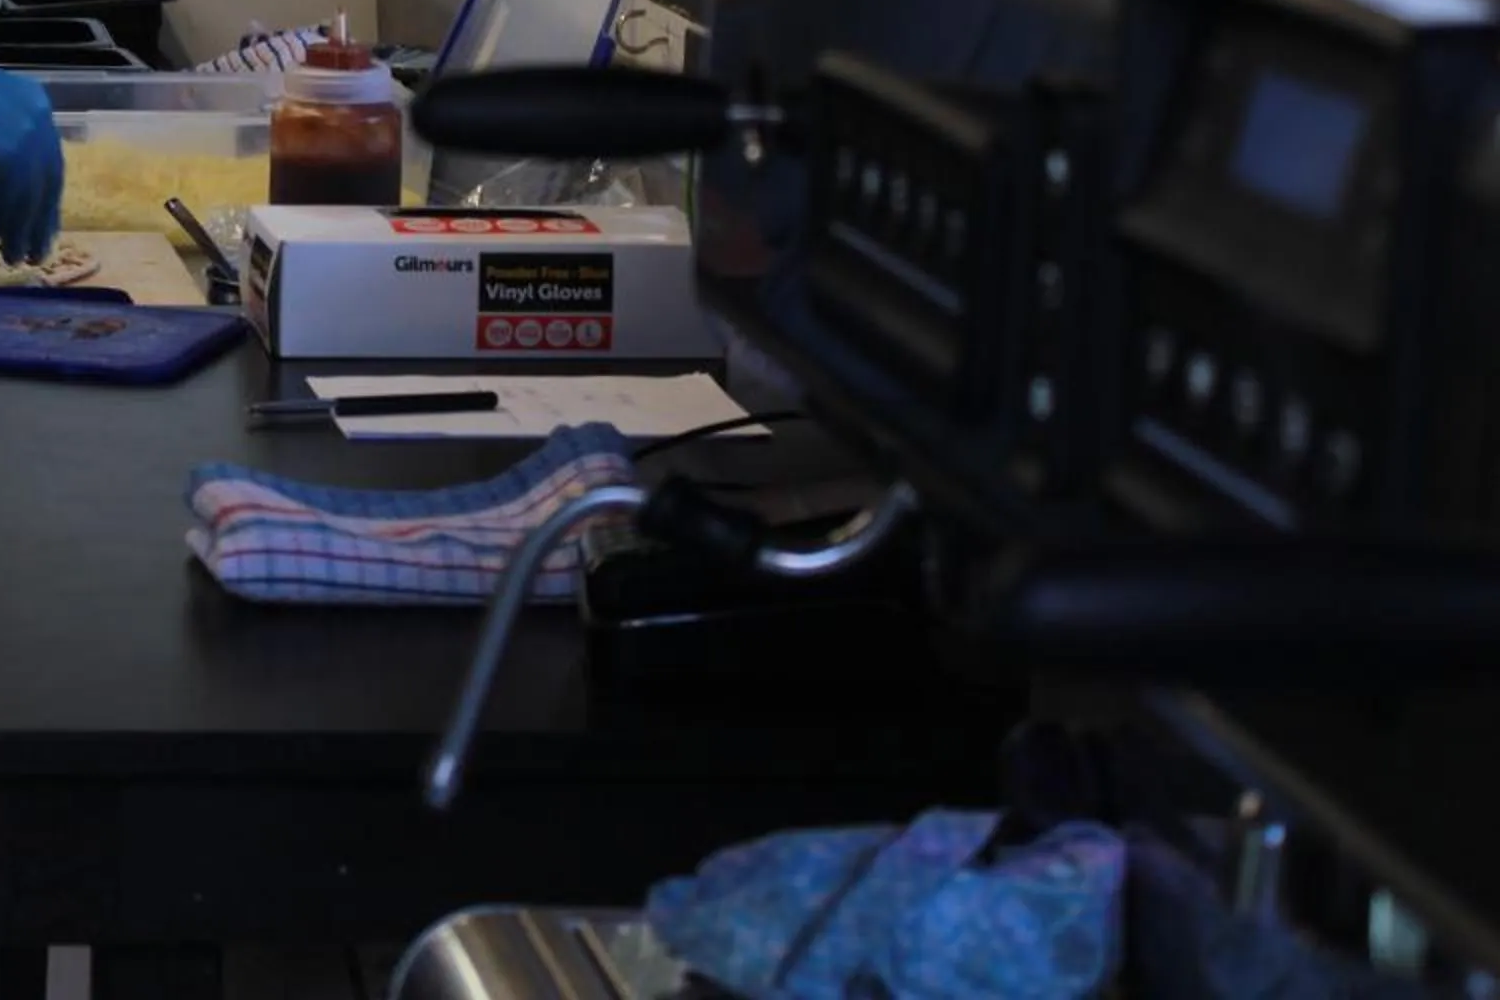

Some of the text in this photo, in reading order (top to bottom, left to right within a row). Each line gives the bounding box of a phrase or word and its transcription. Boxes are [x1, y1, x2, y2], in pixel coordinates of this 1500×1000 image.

[393, 255, 474, 273] Gilmours
[485, 283, 603, 304] Vinyl Gloves
